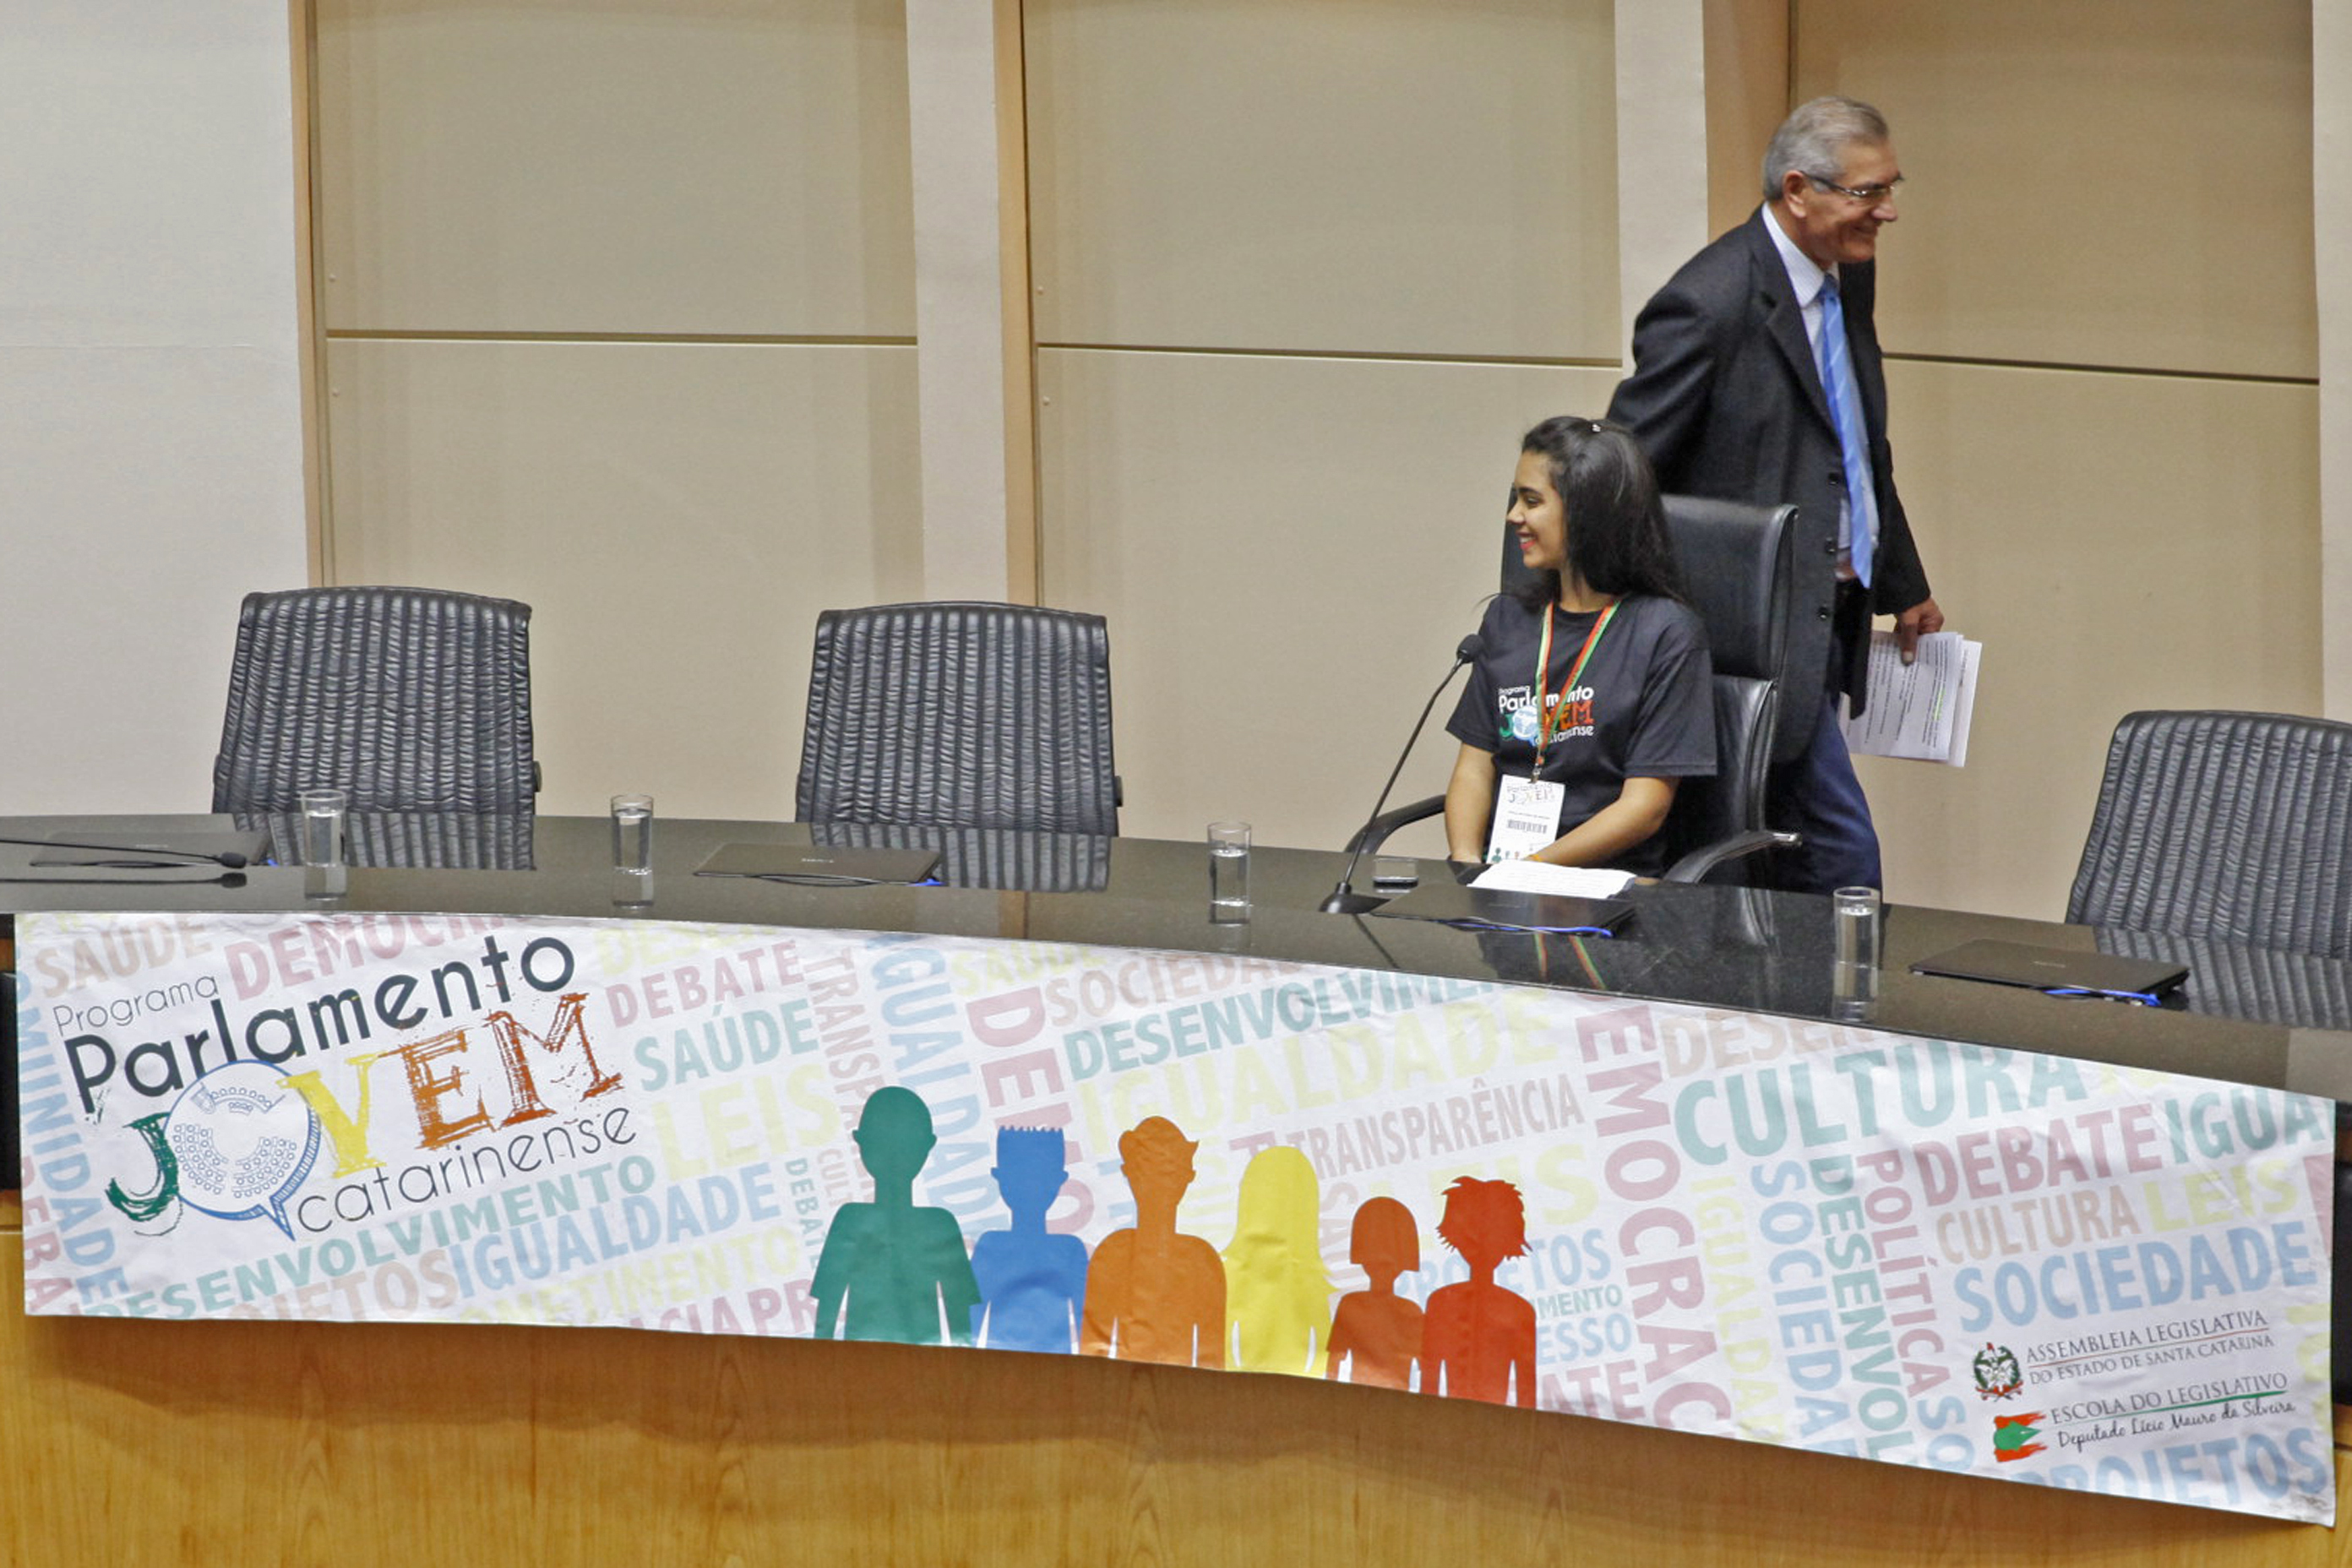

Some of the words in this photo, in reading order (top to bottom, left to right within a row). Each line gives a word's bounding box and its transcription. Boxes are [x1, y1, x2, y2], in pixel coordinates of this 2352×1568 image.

[1499, 685, 1595, 714] Parlamnto
[53, 976, 219, 1037] Programa
[63, 934, 574, 1114] Parlamento
[605, 939, 803, 1028] DEBATE
[634, 998, 819, 1092] SAÚDE
[105, 992, 624, 1242] JOVEM
[650, 1064, 841, 1181] LEIS
[1674, 1040, 2088, 1166] CULTURA
[297, 1108, 636, 1233] catarinense
[1914, 1103, 2163, 1207] DEBATE
[2143, 1158, 2300, 1233] LEIS
[448, 1161, 782, 1298] IGUALDADE
[1936, 1185, 2142, 1264] CULTURA
[1953, 1221, 2317, 1332] SOCIEDADE
[2028, 1330, 2142, 1363] ASSEMBLEIA
[2146, 1309, 2268, 1342] LEGISLATIVA
[2029, 1369, 2054, 1385] DO
[2058, 1358, 2118, 1380] ESTADO
[2121, 1353, 2142, 1368] DE
[2146, 1348, 2196, 1364] SANTA
[2197, 1333, 2275, 1358] CATARINA
[2051, 1398, 2127, 1424] ESCOLA
[2130, 1393, 2163, 1413] DO
[2168, 1372, 2289, 1406] LEGISLATIVO
[2058, 1421, 2126, 1452] Deputado
